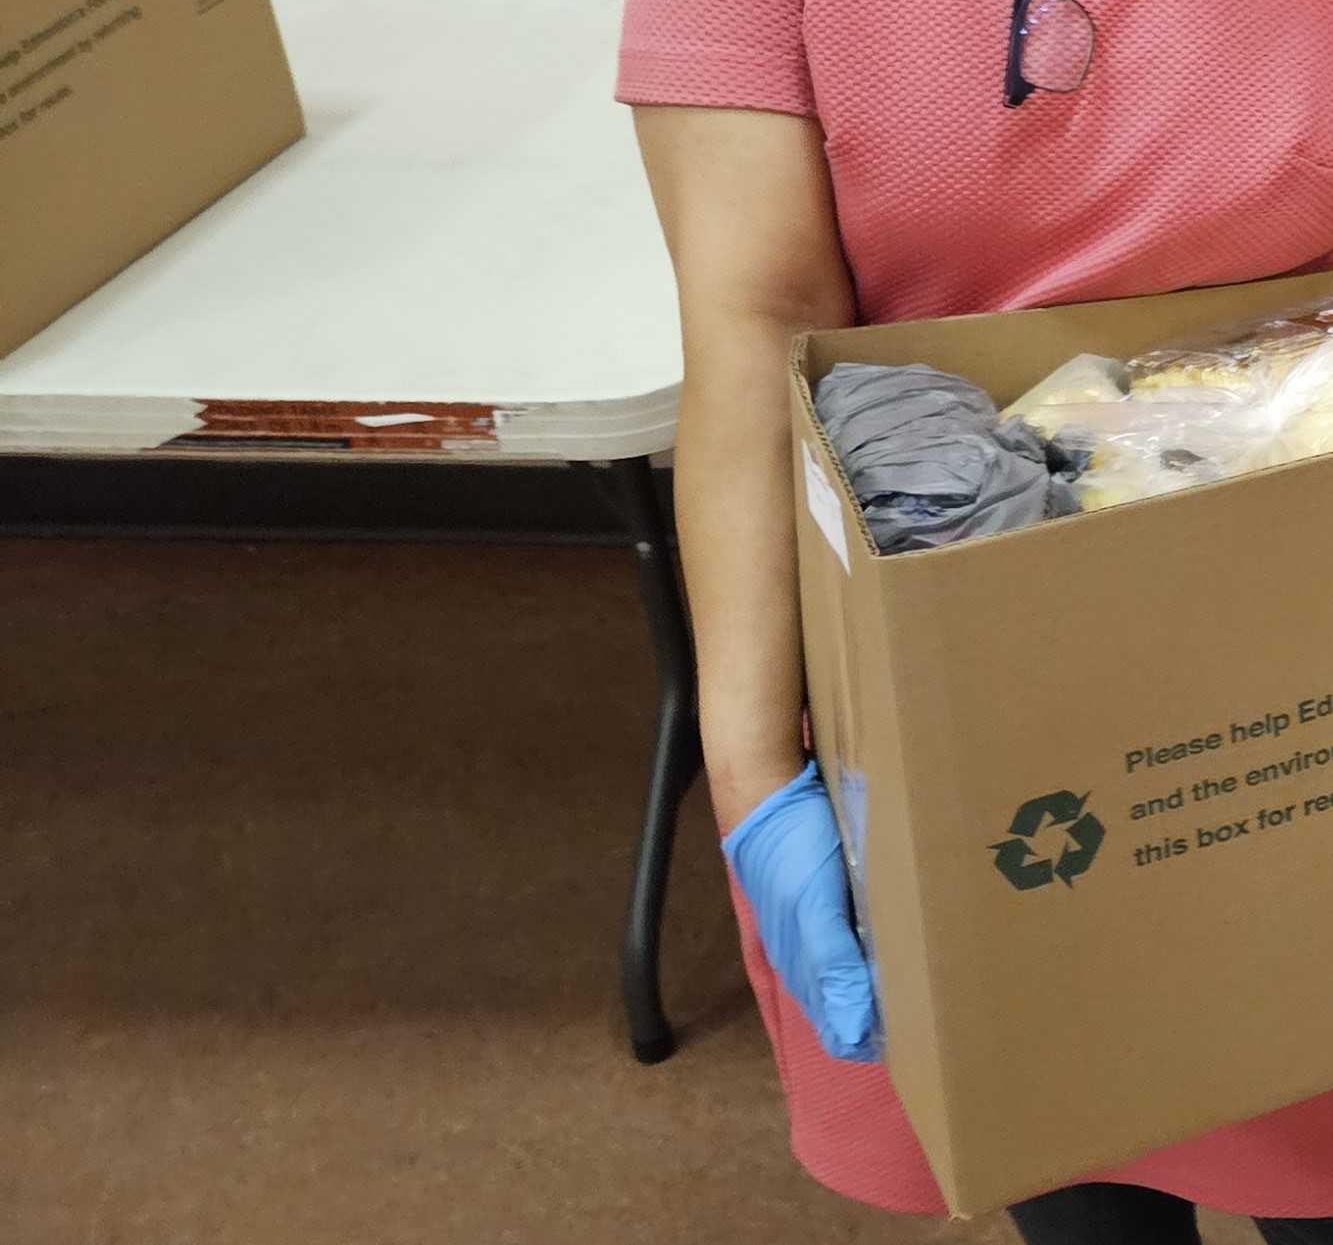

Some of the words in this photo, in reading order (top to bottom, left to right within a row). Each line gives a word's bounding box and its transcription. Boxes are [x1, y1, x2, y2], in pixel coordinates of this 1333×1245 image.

[1126, 728, 1222, 774] Please
[1230, 712, 1290, 744] help
[1130, 787, 1183, 821] and
[1193, 774, 1237, 802] the
[1134, 838, 1188, 867] this
[1197, 818, 1250, 847] box
[1257, 802, 1296, 830] for
